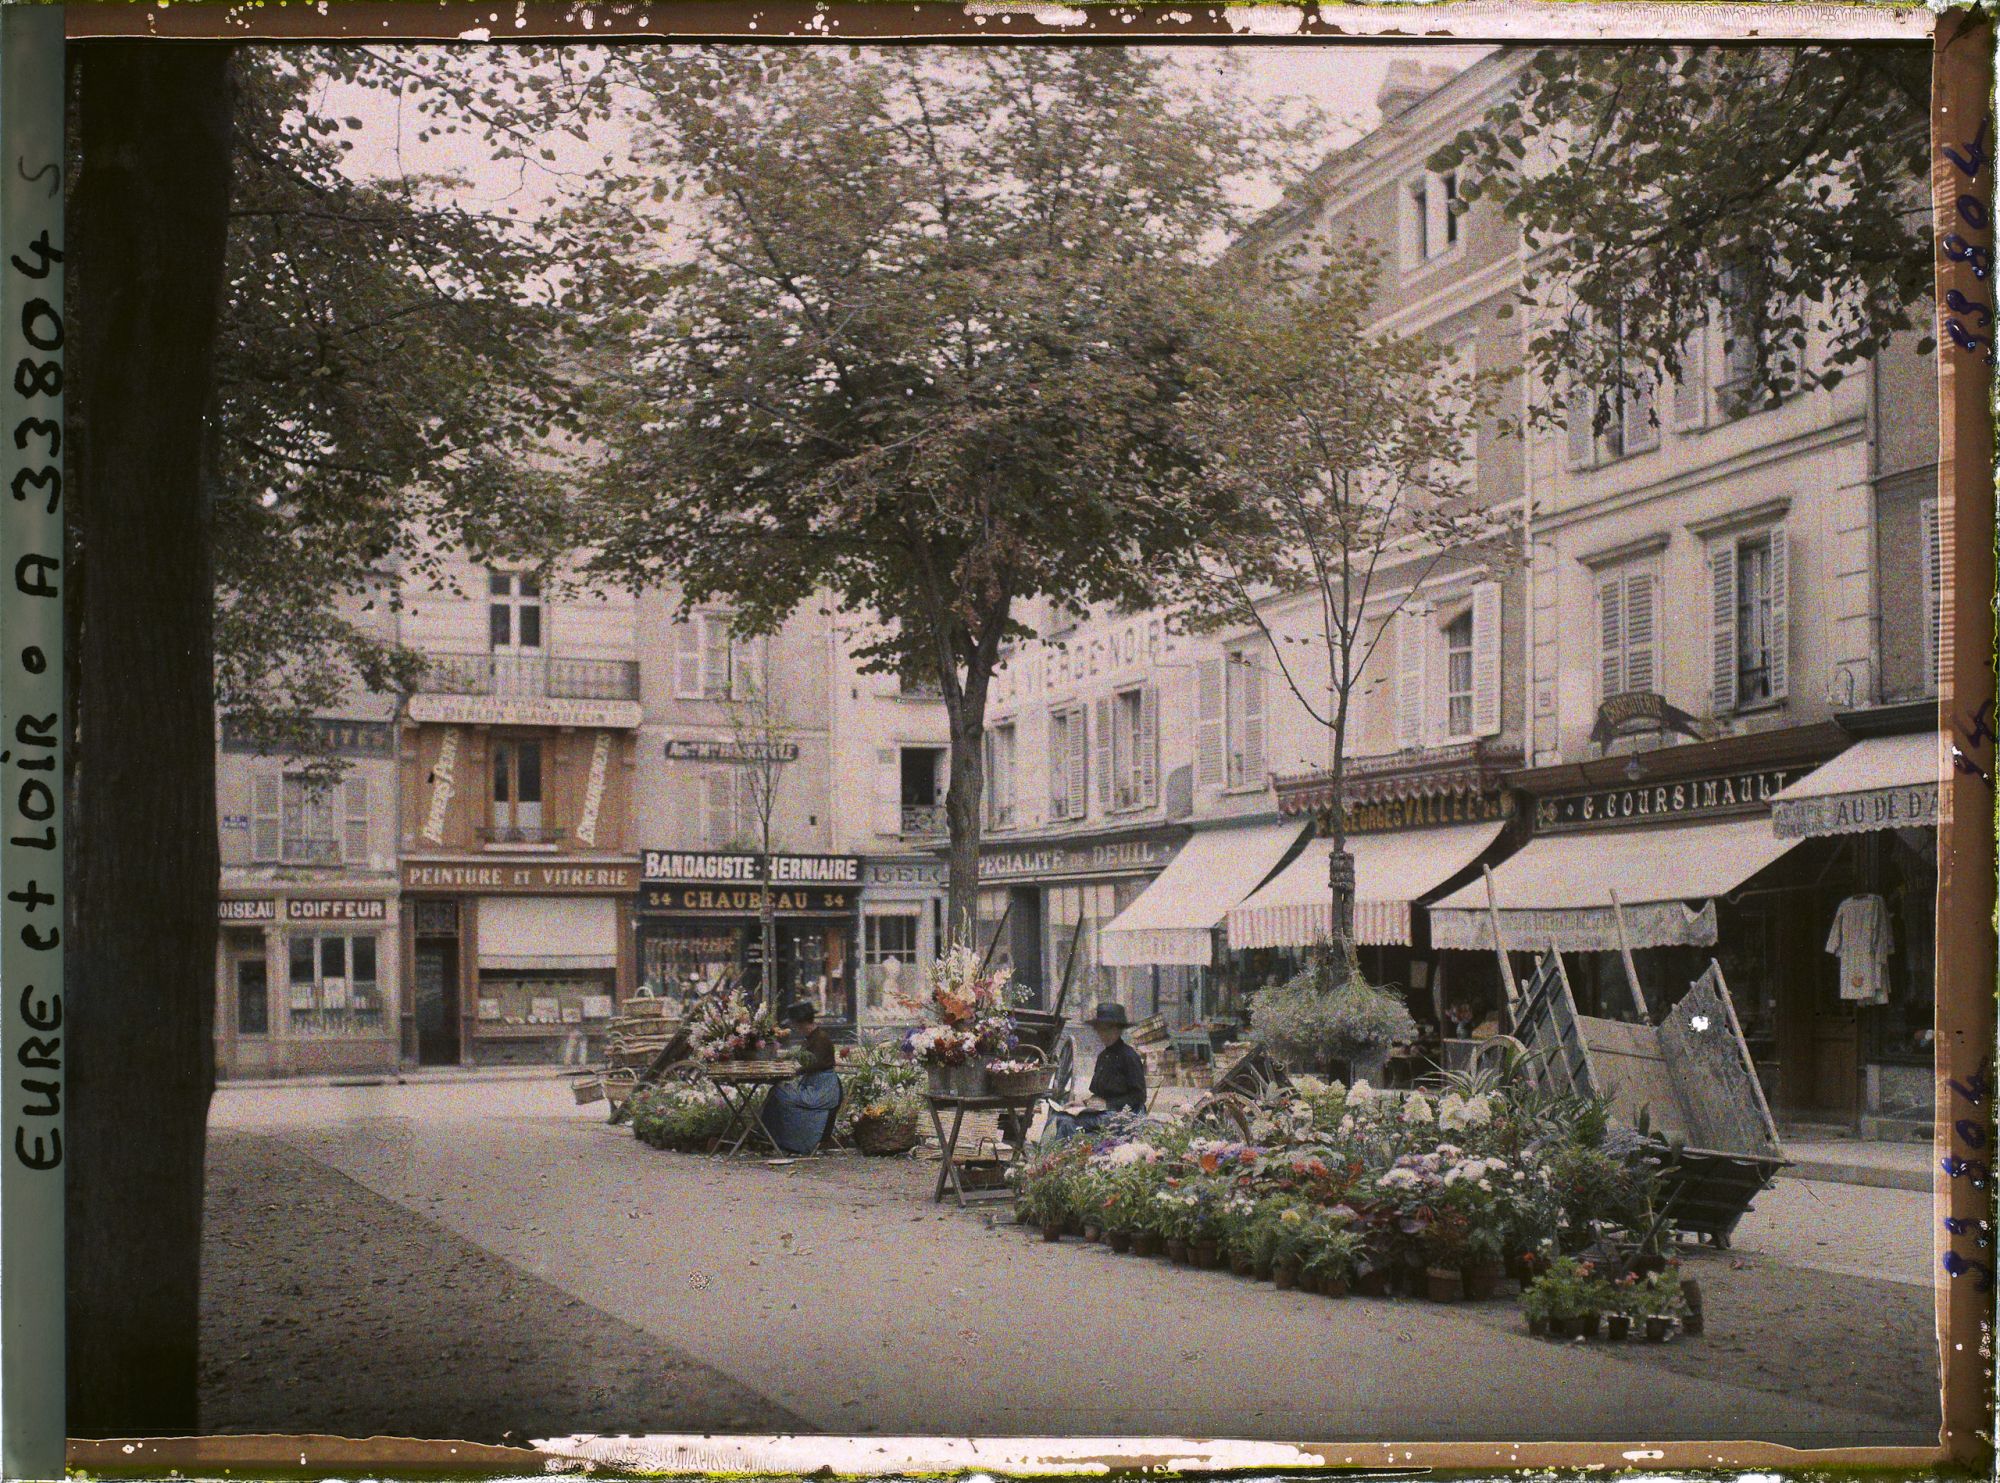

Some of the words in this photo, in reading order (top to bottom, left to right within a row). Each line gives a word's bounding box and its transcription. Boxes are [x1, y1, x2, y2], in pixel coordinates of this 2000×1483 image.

[10, 229, 64, 515] 33804
[14, 553, 61, 599] A
[1837, 799, 1865, 825] AU
[646, 853, 754, 880] BANDAGISTE
[1094, 842, 1154, 866] DEUIL
[409, 868, 502, 885] PEINTURE
[513, 871, 530, 884] ET
[543, 870, 628, 885] VITRERIE
[290, 901, 382, 918] COIFFEUR
[650, 893, 671, 905] 34
[824, 894, 844, 907] 34
[8, 879, 59, 951] et
[14, 984, 64, 1172] EURE
